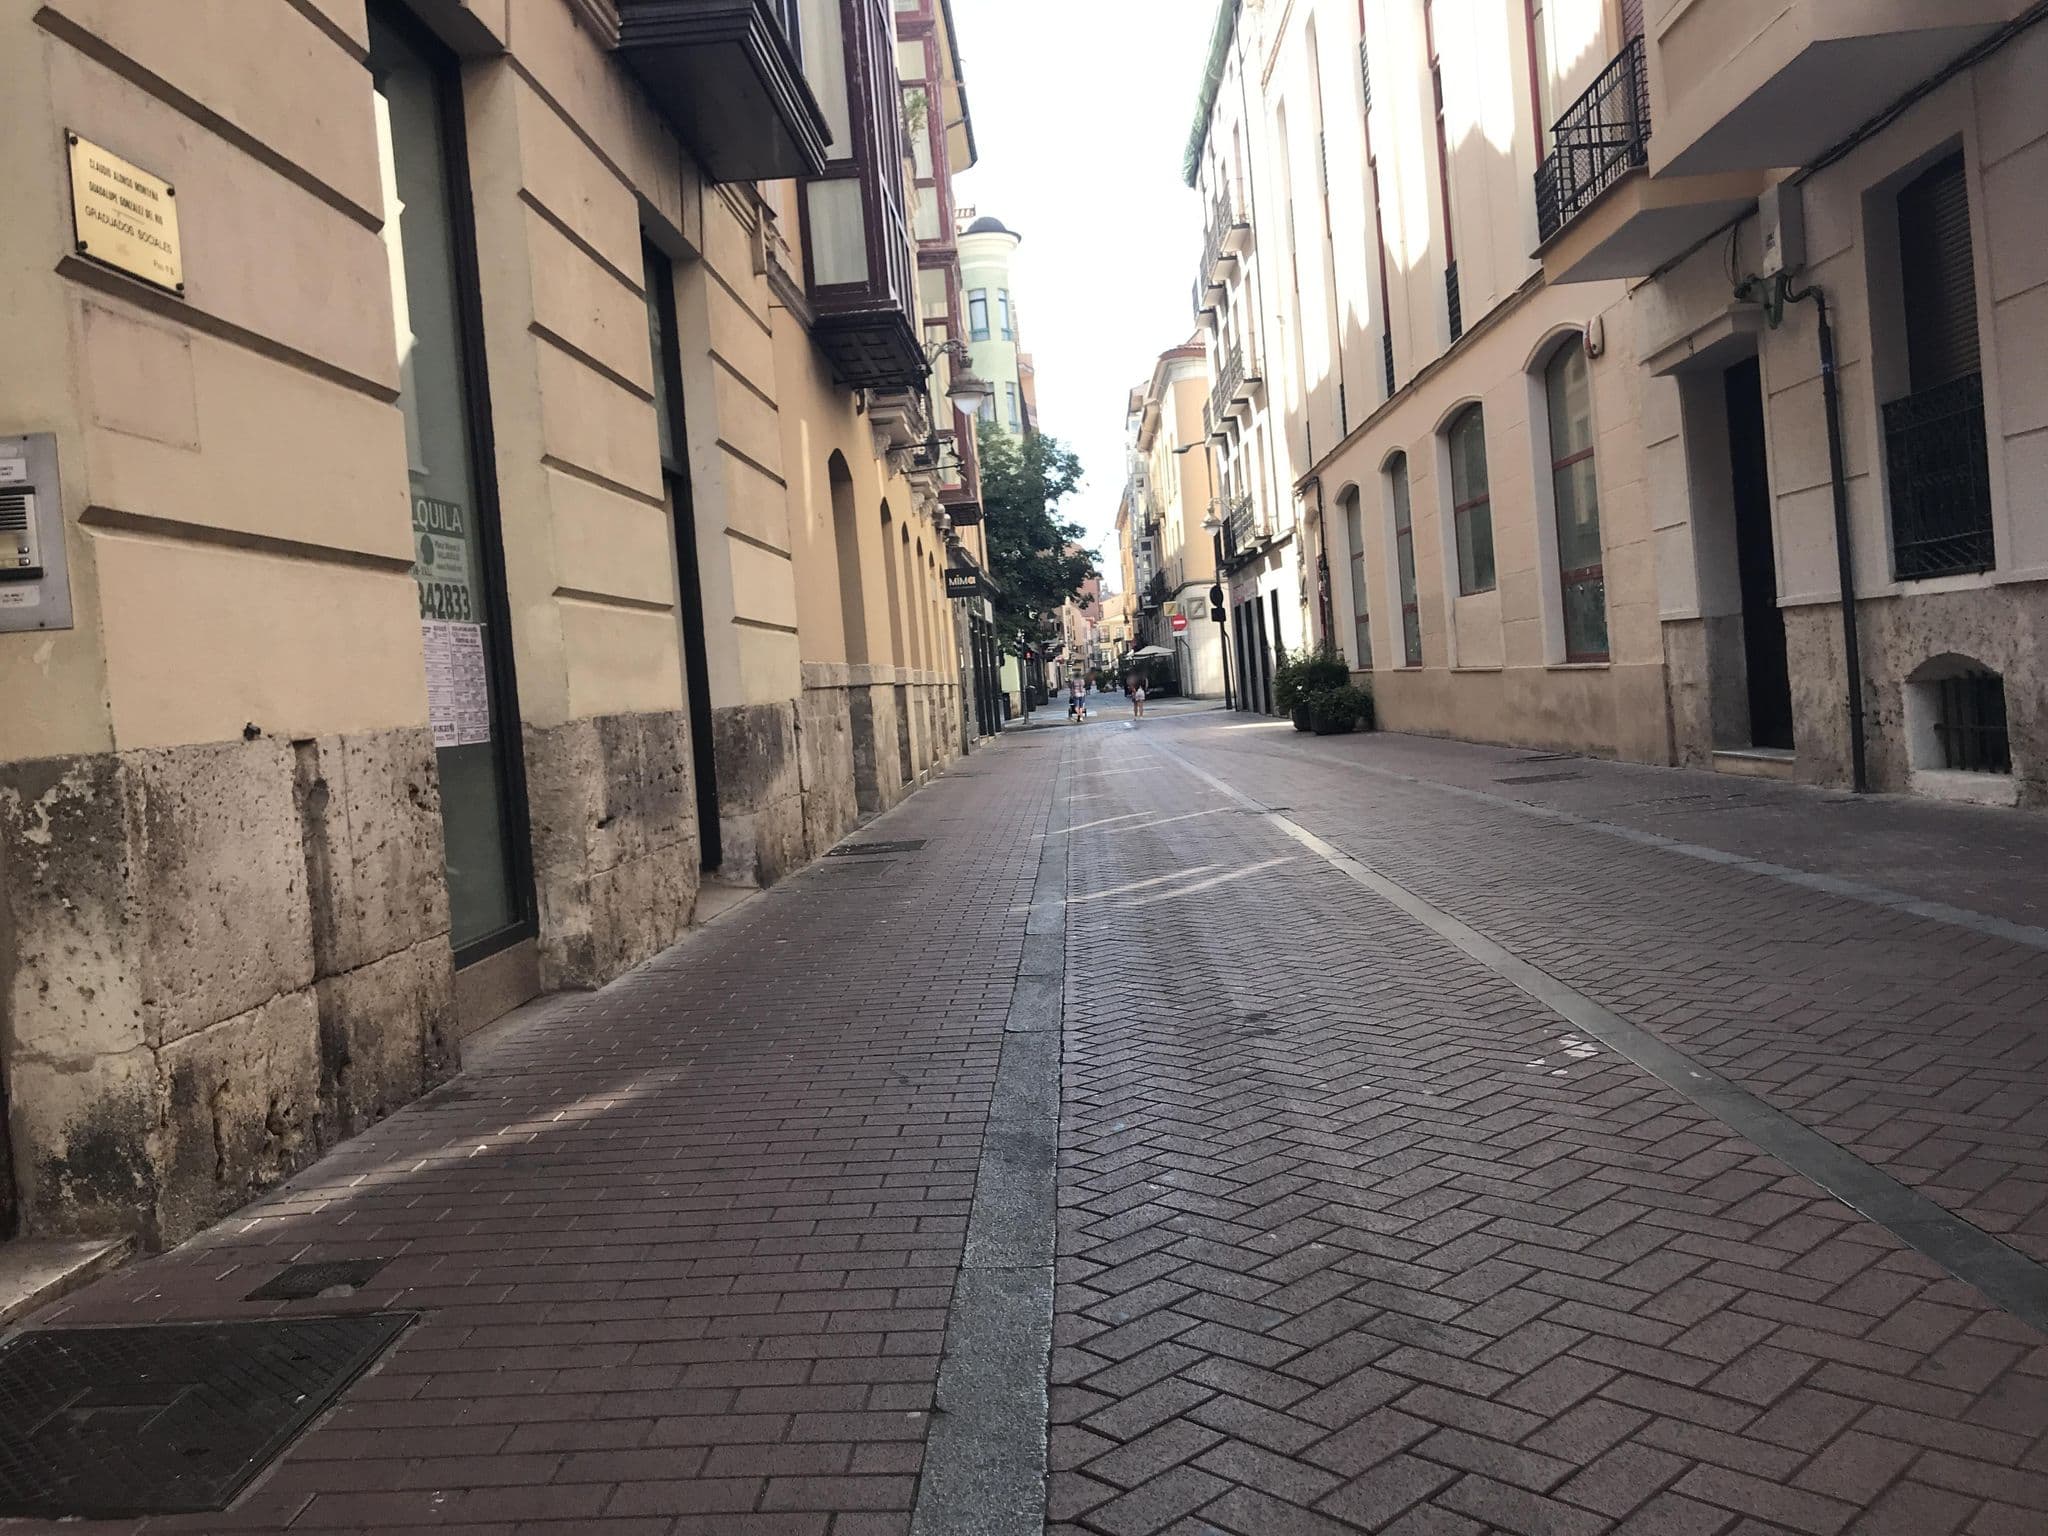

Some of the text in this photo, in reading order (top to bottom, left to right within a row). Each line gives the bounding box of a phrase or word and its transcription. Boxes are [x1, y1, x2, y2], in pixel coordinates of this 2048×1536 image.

[85, 205, 173, 254] GRADUADOS SOCIALES
[413, 500, 463, 533] QUILA
